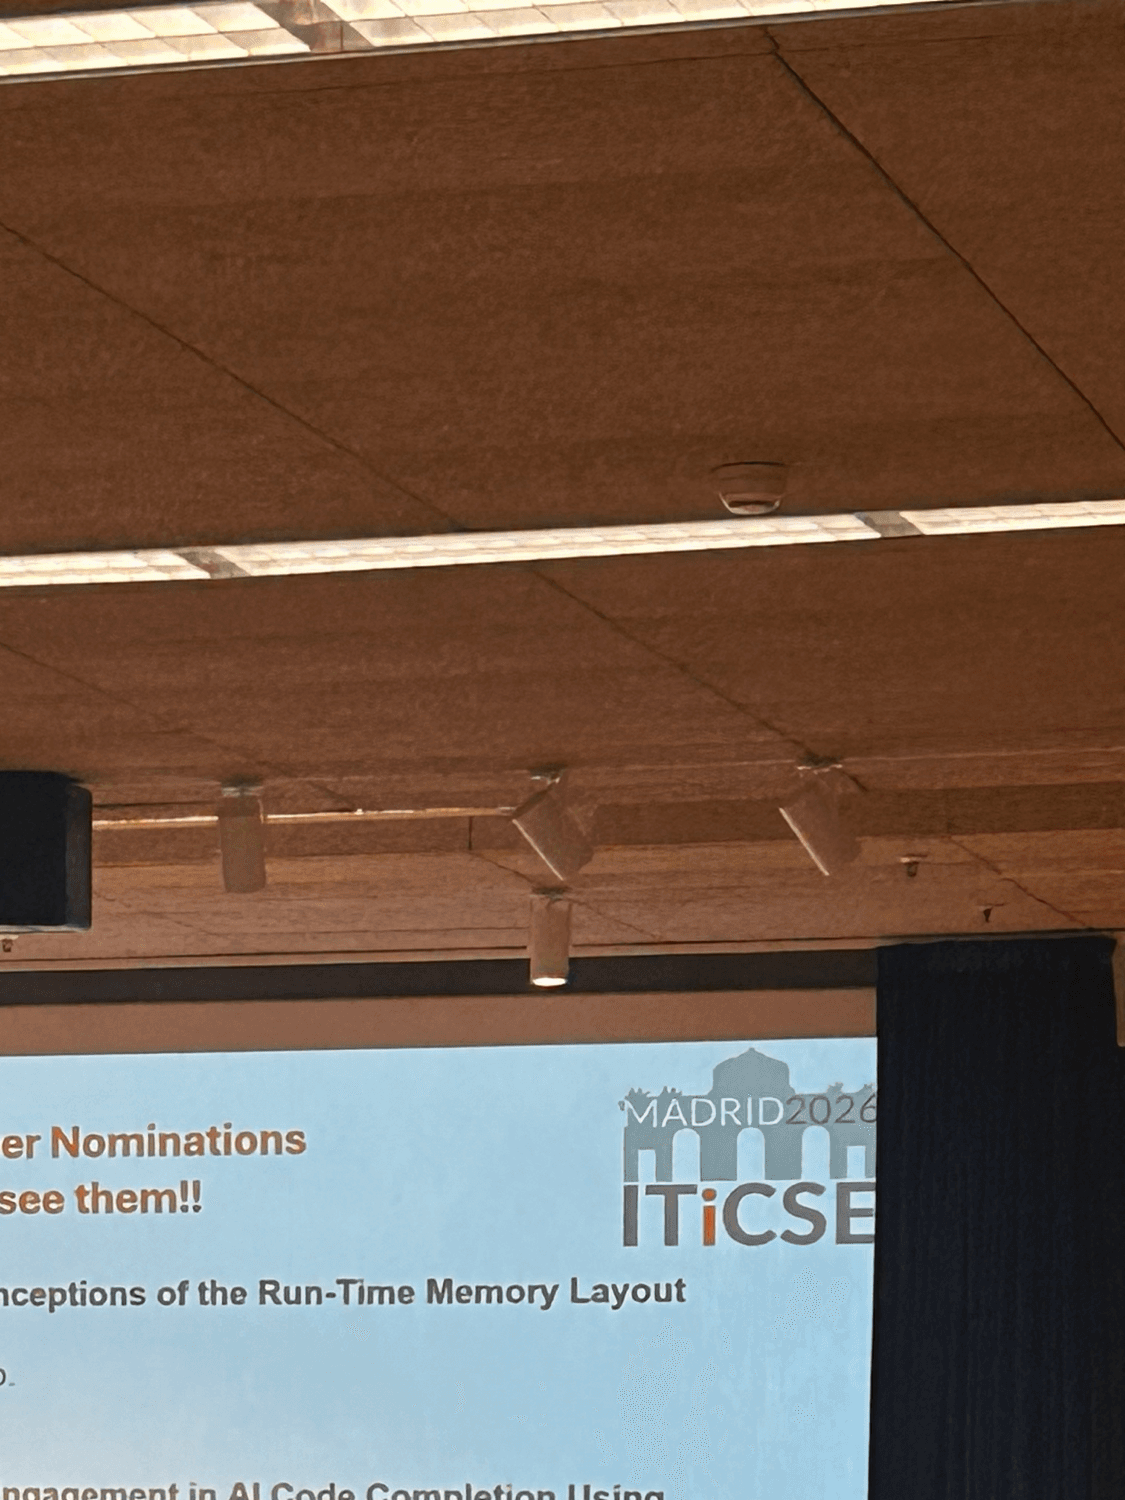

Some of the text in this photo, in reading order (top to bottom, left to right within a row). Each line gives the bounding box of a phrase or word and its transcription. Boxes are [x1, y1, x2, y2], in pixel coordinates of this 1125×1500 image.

[51, 1123, 306, 1158] Nominations
[74, 1180, 201, 1214] them!!
[623, 1181, 875, 1246] ITiCSE
[157, 1280, 189, 1306] of
[198, 1279, 247, 1306] the
[259, 1279, 415, 1305] Run-Time
[427, 1278, 559, 1310] Memory
[571, 1277, 686, 1310] Layout
